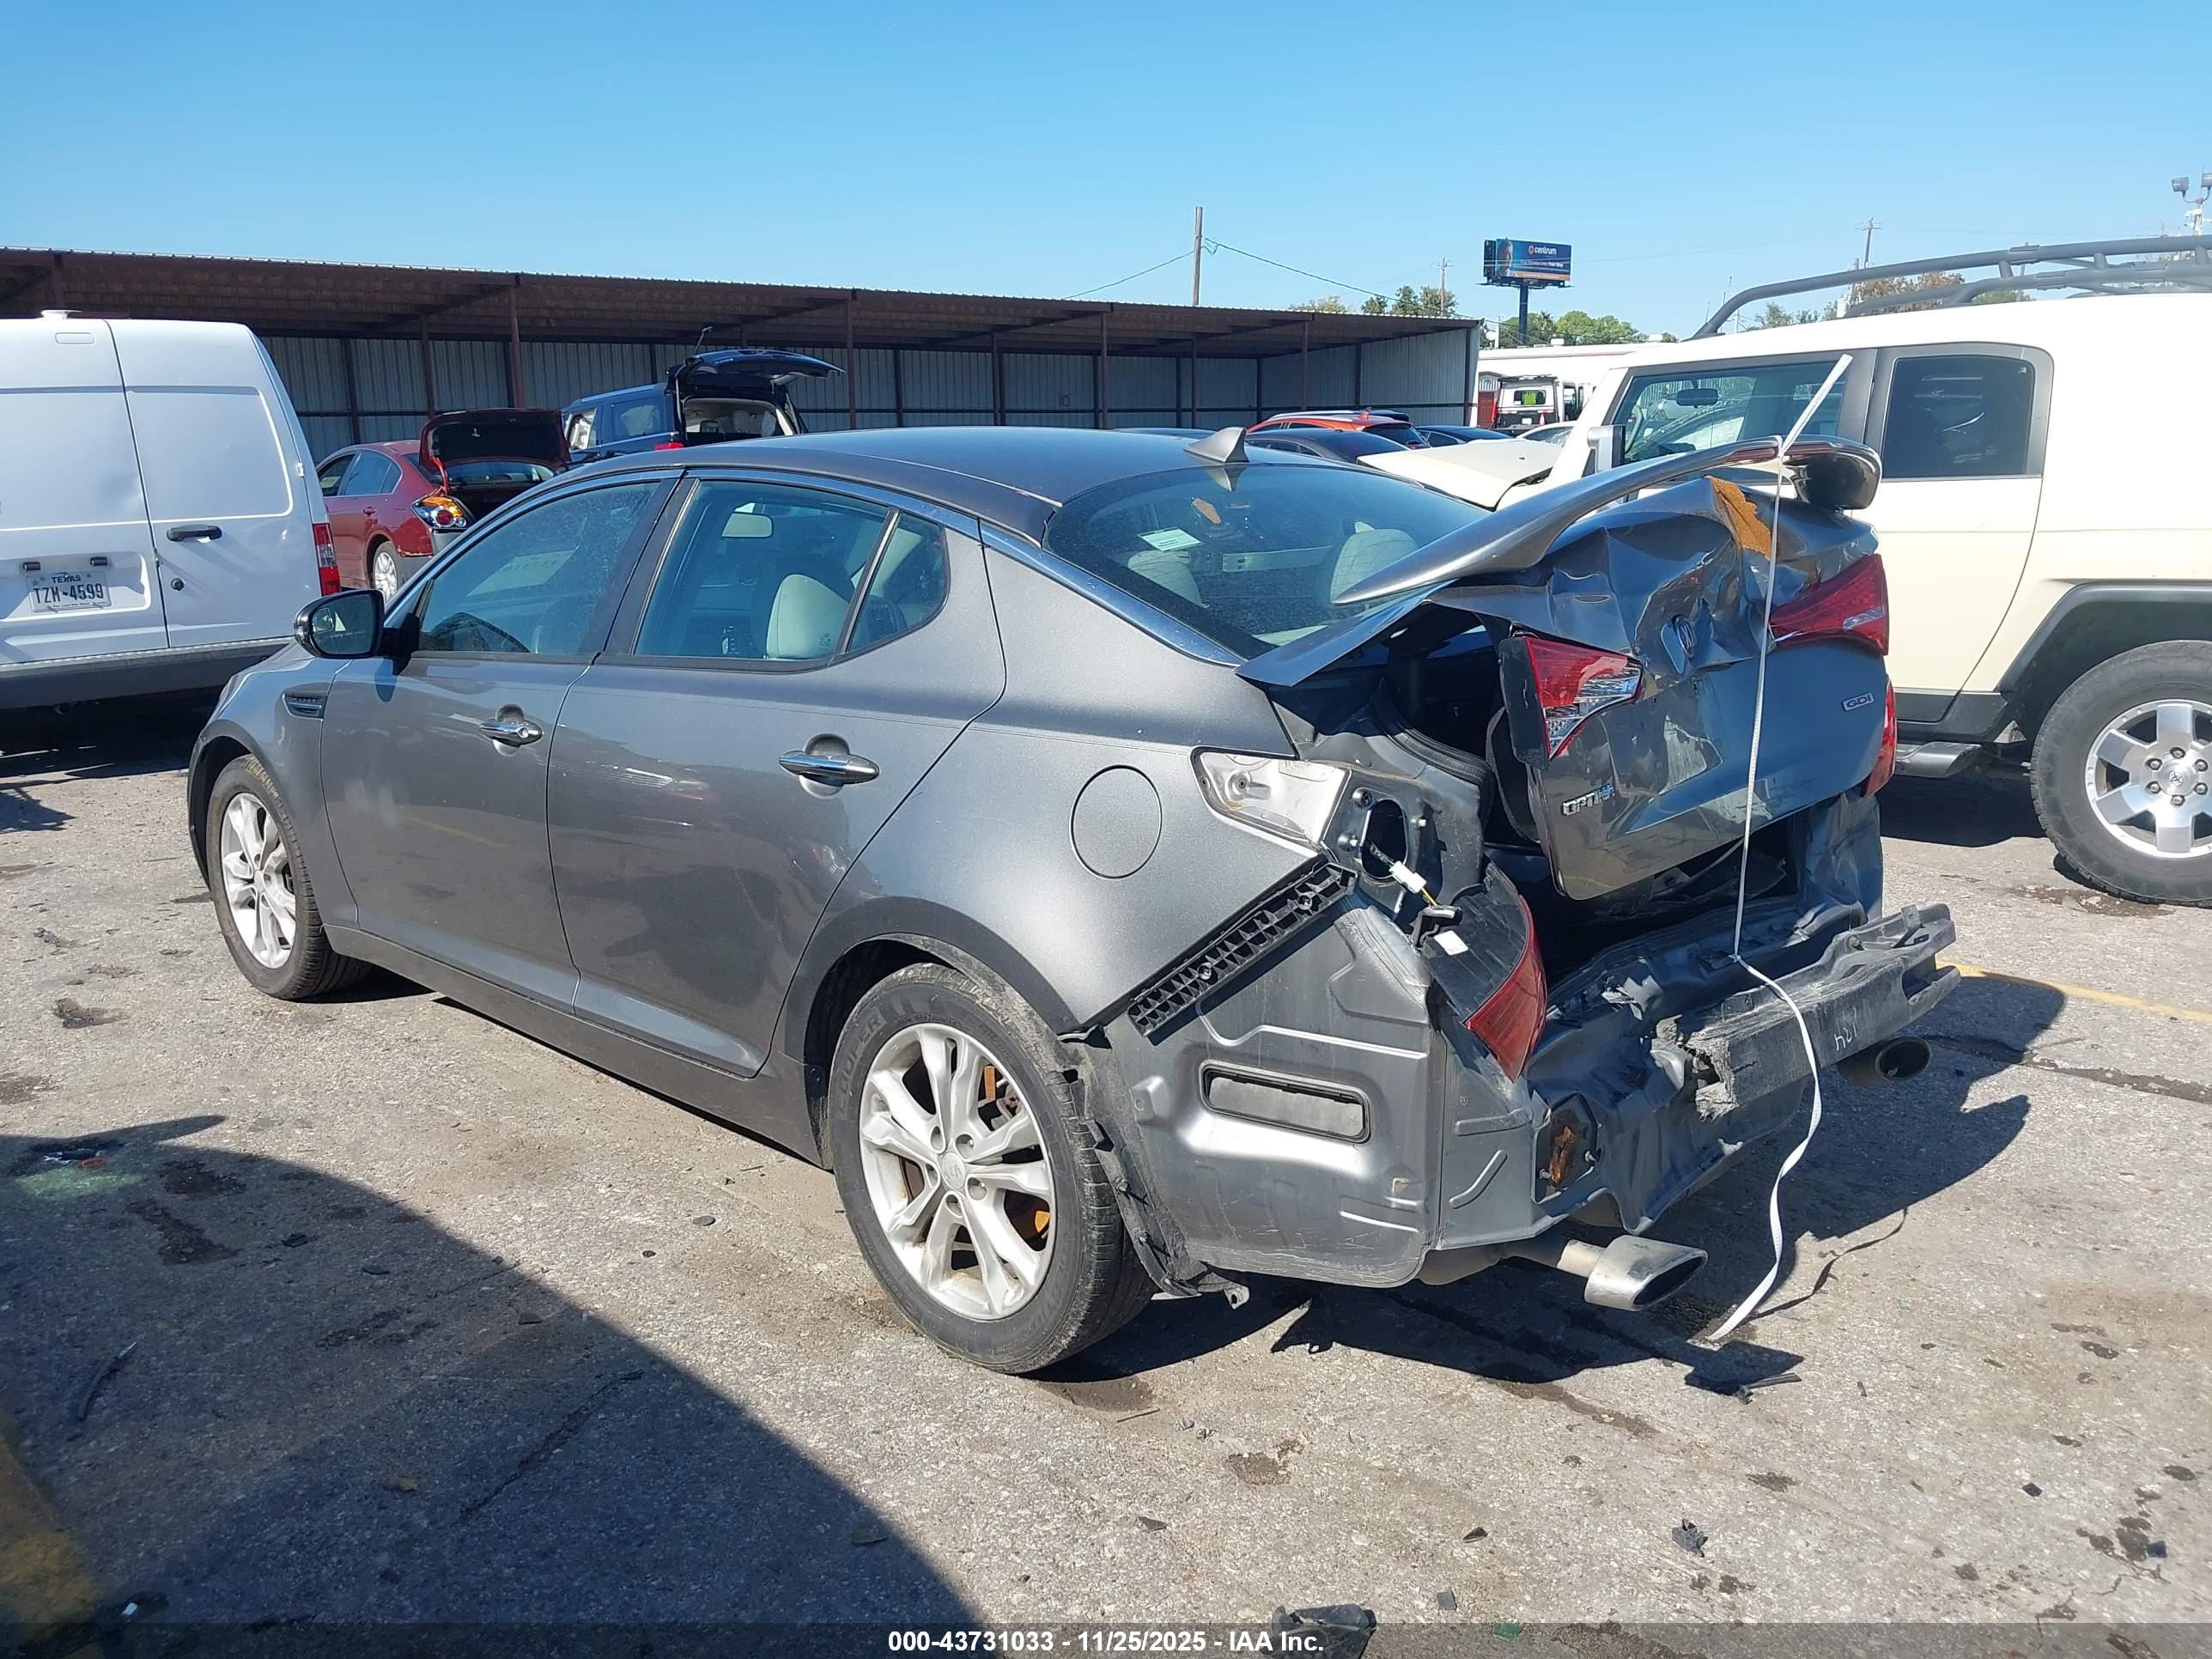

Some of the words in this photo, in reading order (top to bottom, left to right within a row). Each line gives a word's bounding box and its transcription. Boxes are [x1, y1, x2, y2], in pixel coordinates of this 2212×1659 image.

[1534, 246, 1557, 255] centrum
[51, 574, 82, 583] TEXAS
[1846, 694, 1872, 708] GDI
